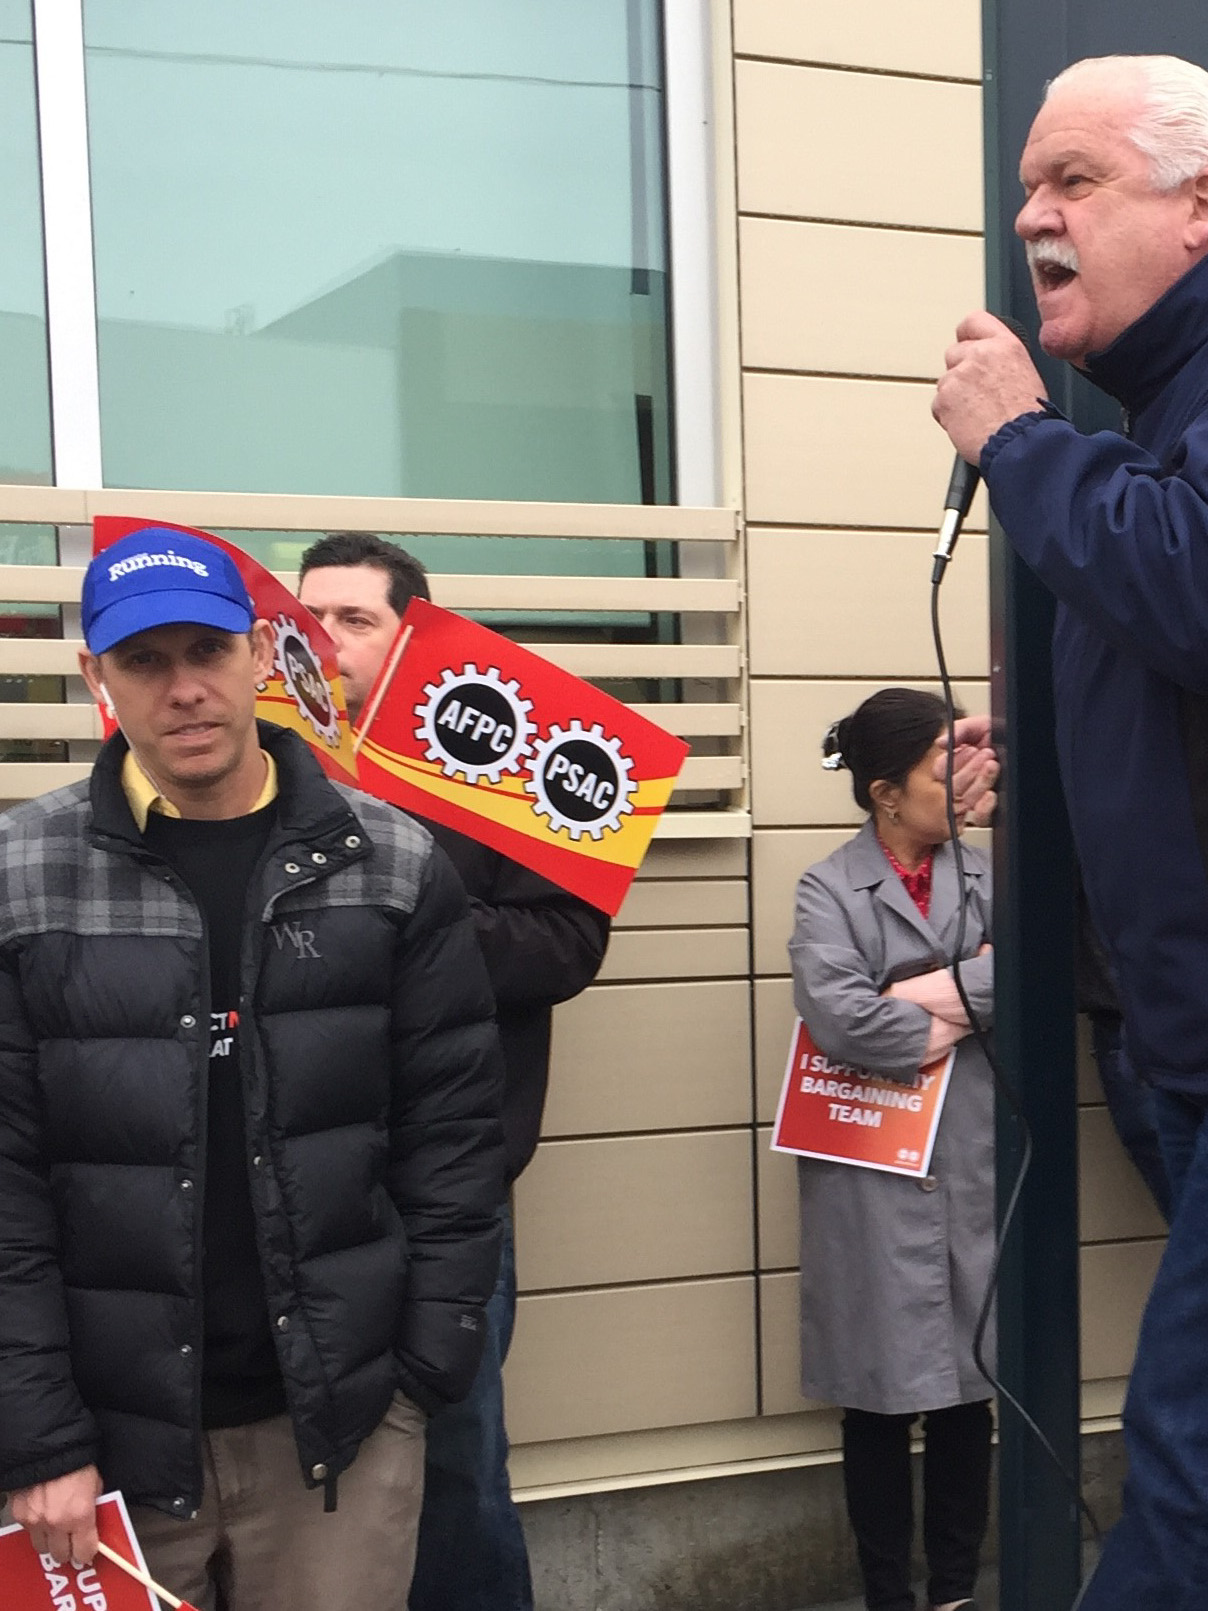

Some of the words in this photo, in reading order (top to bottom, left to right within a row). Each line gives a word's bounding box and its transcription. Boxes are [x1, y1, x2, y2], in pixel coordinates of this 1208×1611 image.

[107, 549, 209, 582] Running
[437, 699, 514, 753] AFPC
[545, 753, 615, 810] PSAC
[271, 921, 323, 959] WR
[800, 1052, 809, 1070] I
[800, 1076, 924, 1113] BARGAINING
[828, 1102, 883, 1128] TEAM
